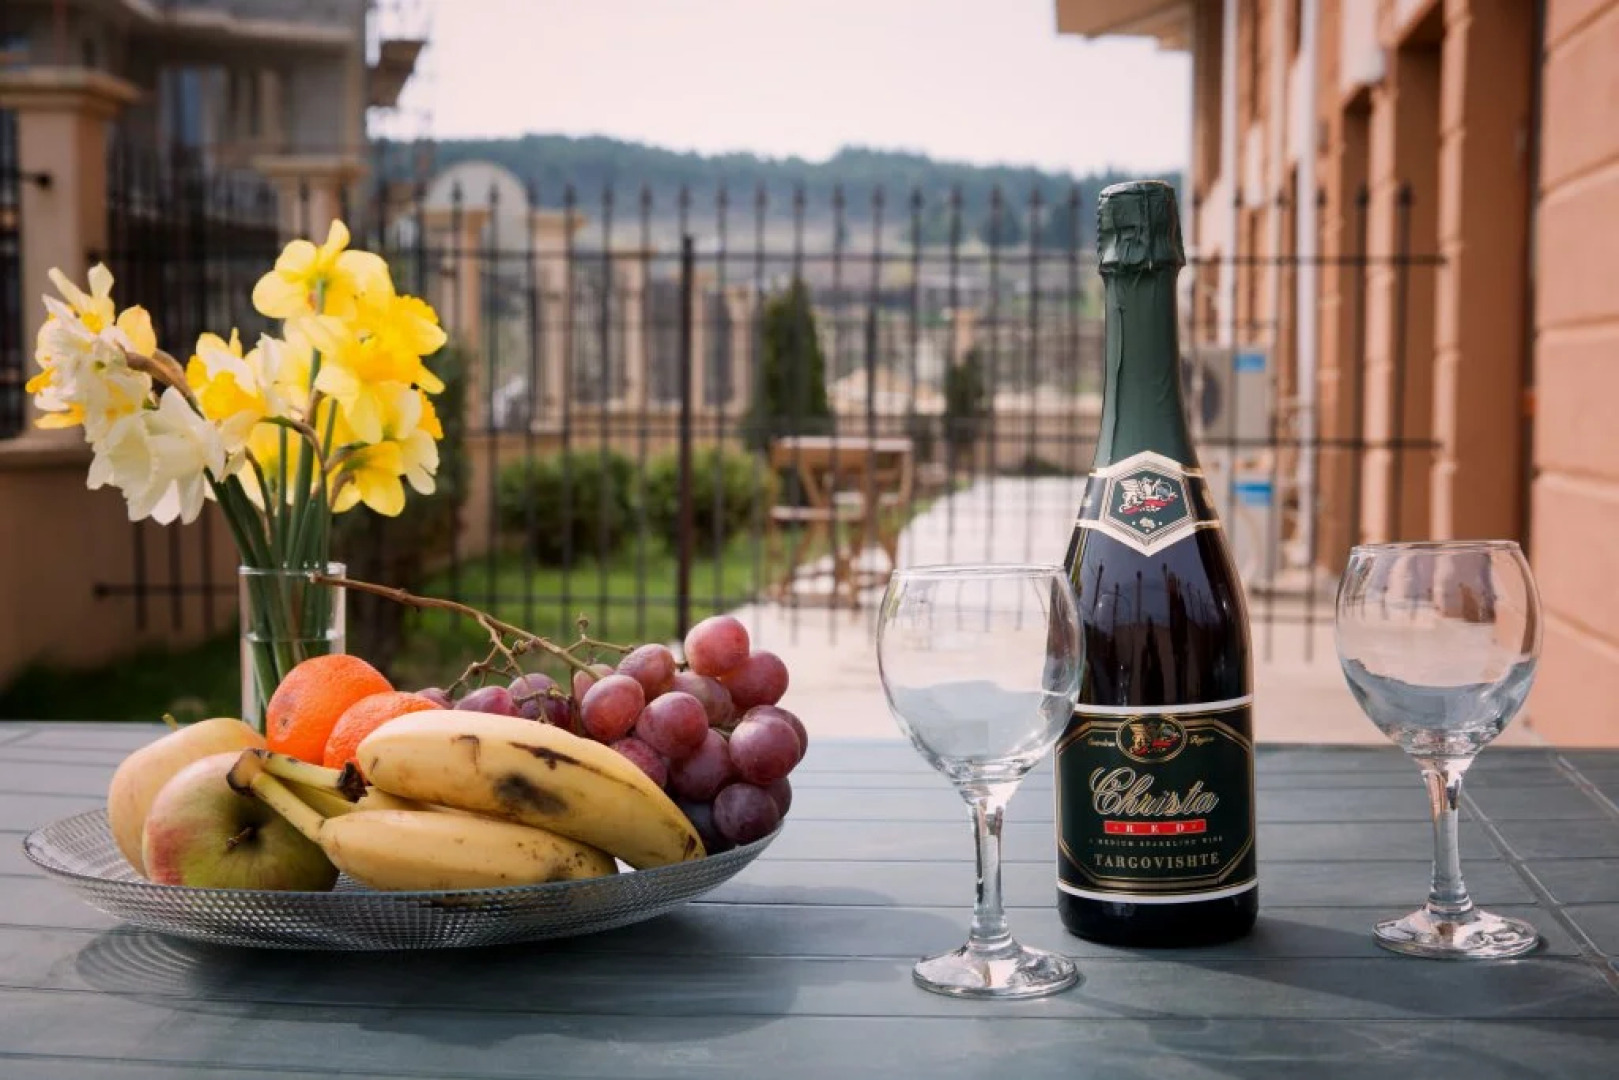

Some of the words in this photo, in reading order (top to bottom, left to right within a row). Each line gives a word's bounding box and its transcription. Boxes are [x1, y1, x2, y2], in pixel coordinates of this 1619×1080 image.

[1089, 766, 1220, 816] Christa
[1126, 823, 1185, 833] RED
[1093, 852, 1220, 869] TARGOVISHTE
